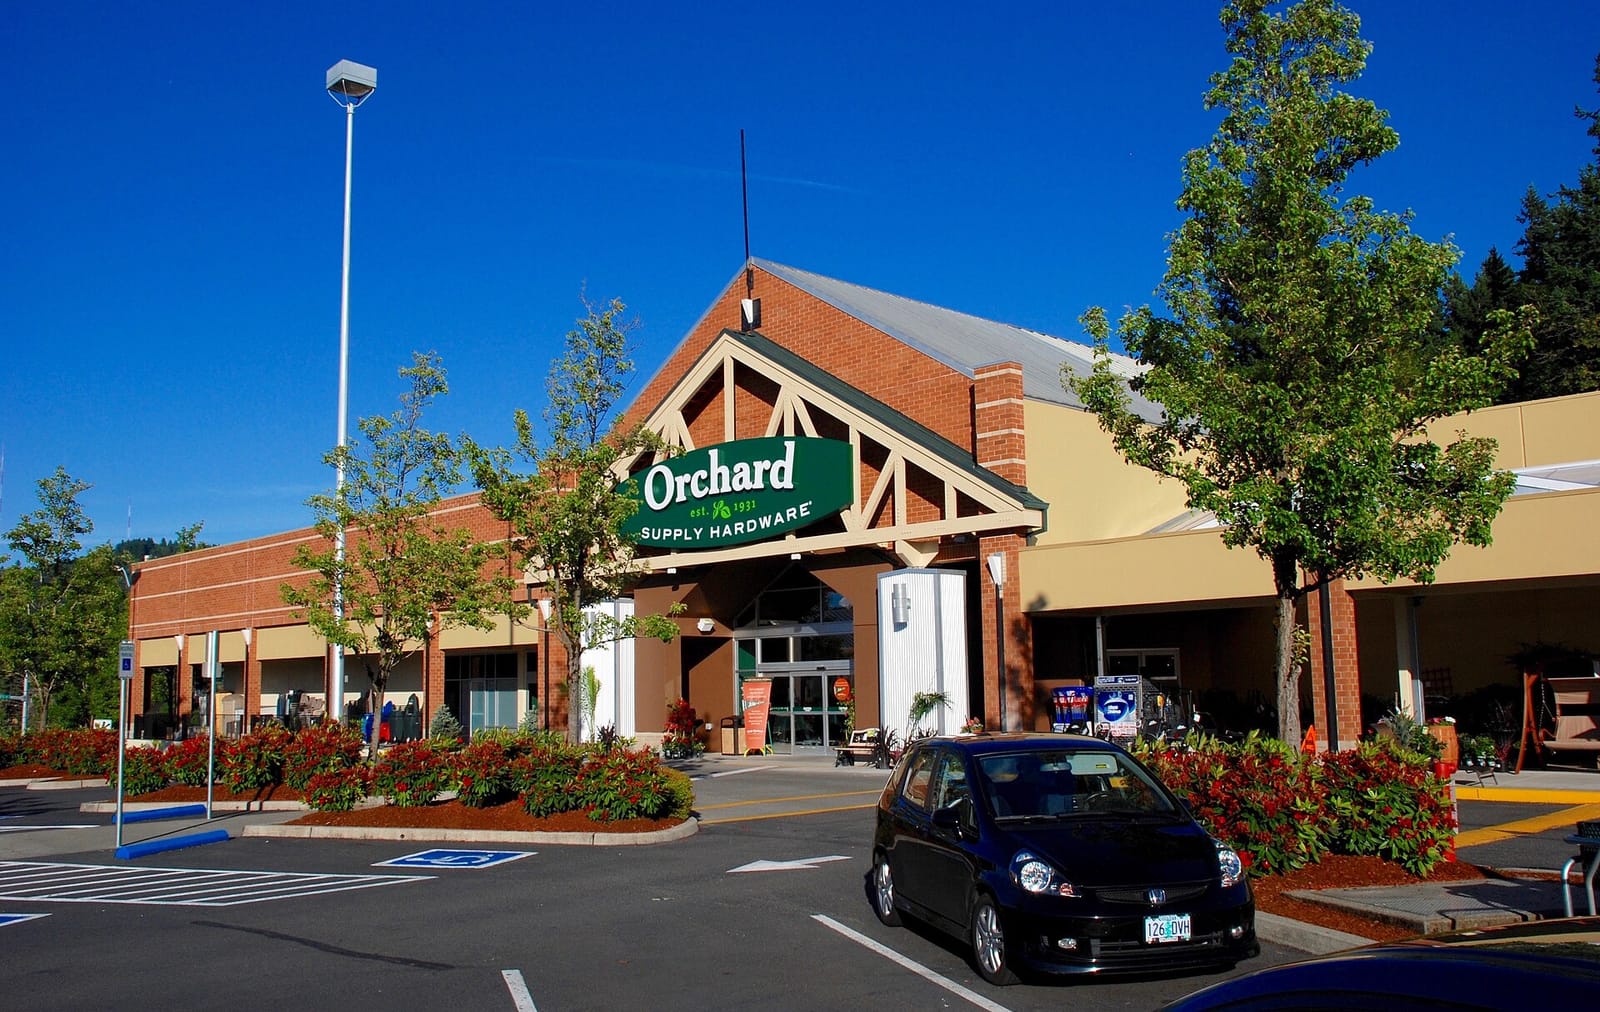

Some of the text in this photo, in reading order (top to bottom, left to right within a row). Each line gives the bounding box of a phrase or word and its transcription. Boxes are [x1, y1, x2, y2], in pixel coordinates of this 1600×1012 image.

[644, 440, 796, 511] Orchard
[690, 500, 757, 518] est. 1931
[641, 526, 704, 541] SUPPLY
[1148, 920, 1190, 937] 126 DVH
